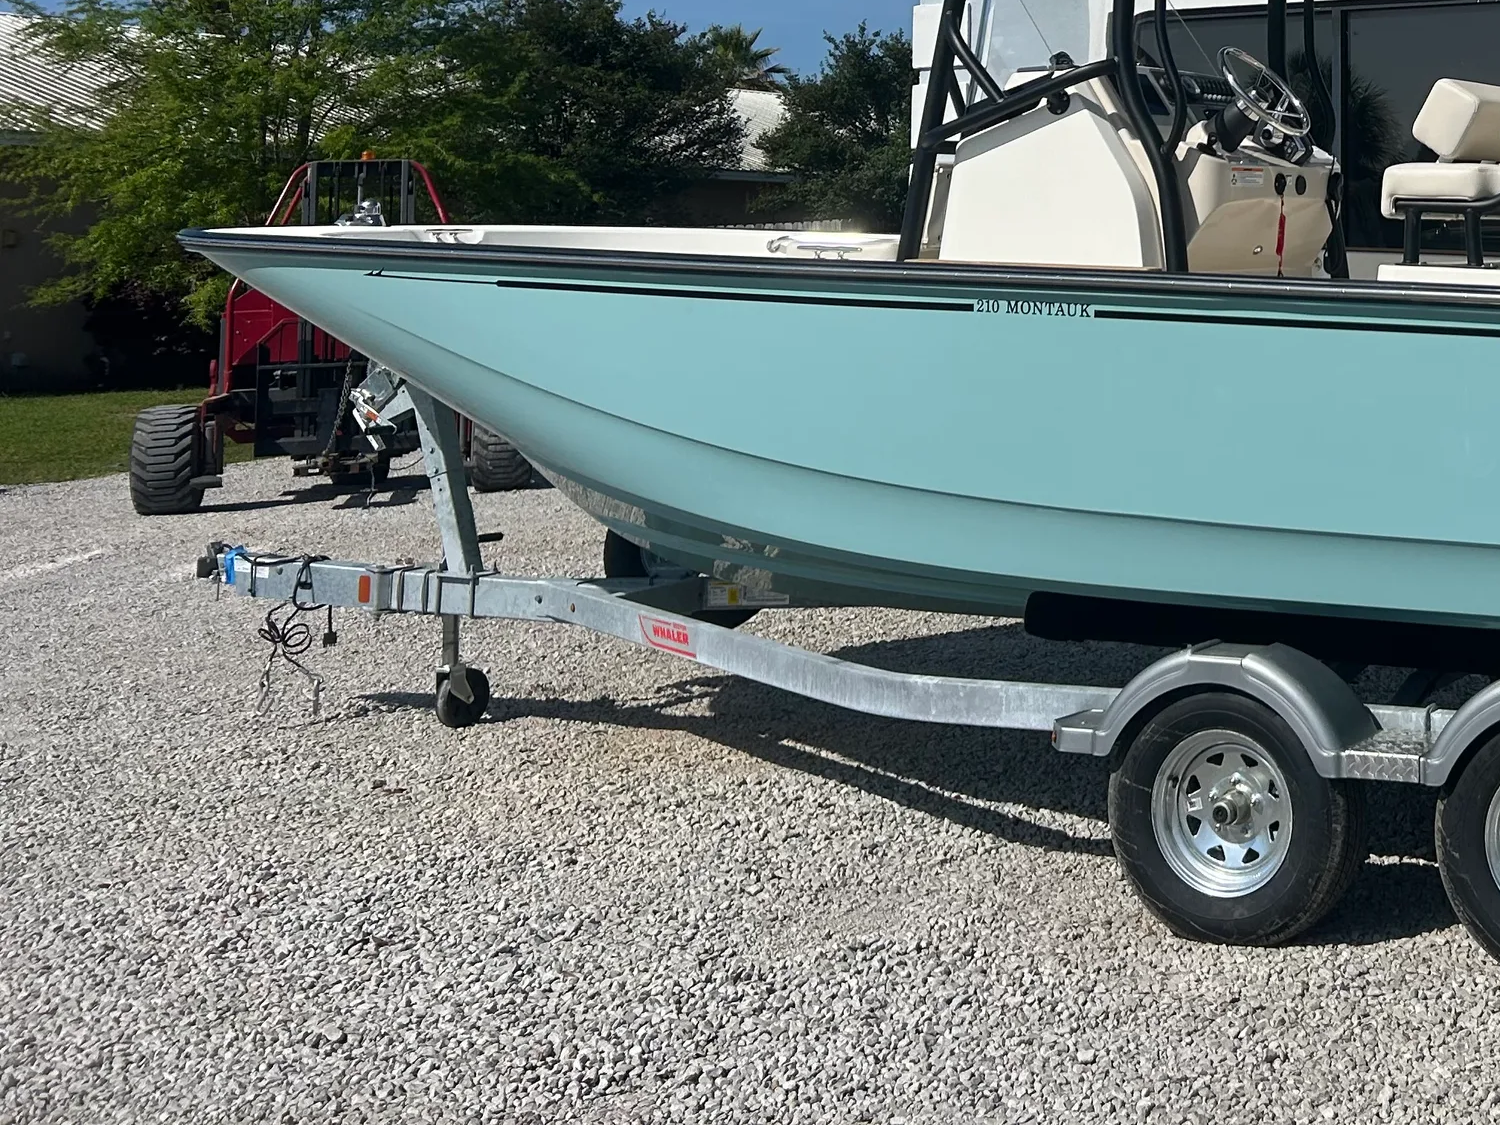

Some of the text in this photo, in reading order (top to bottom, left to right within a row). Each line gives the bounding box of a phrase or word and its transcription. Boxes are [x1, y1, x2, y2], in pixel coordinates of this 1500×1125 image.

[976, 298, 1092, 318] 210 MONTAUK
[652, 624, 689, 646] WHALER
